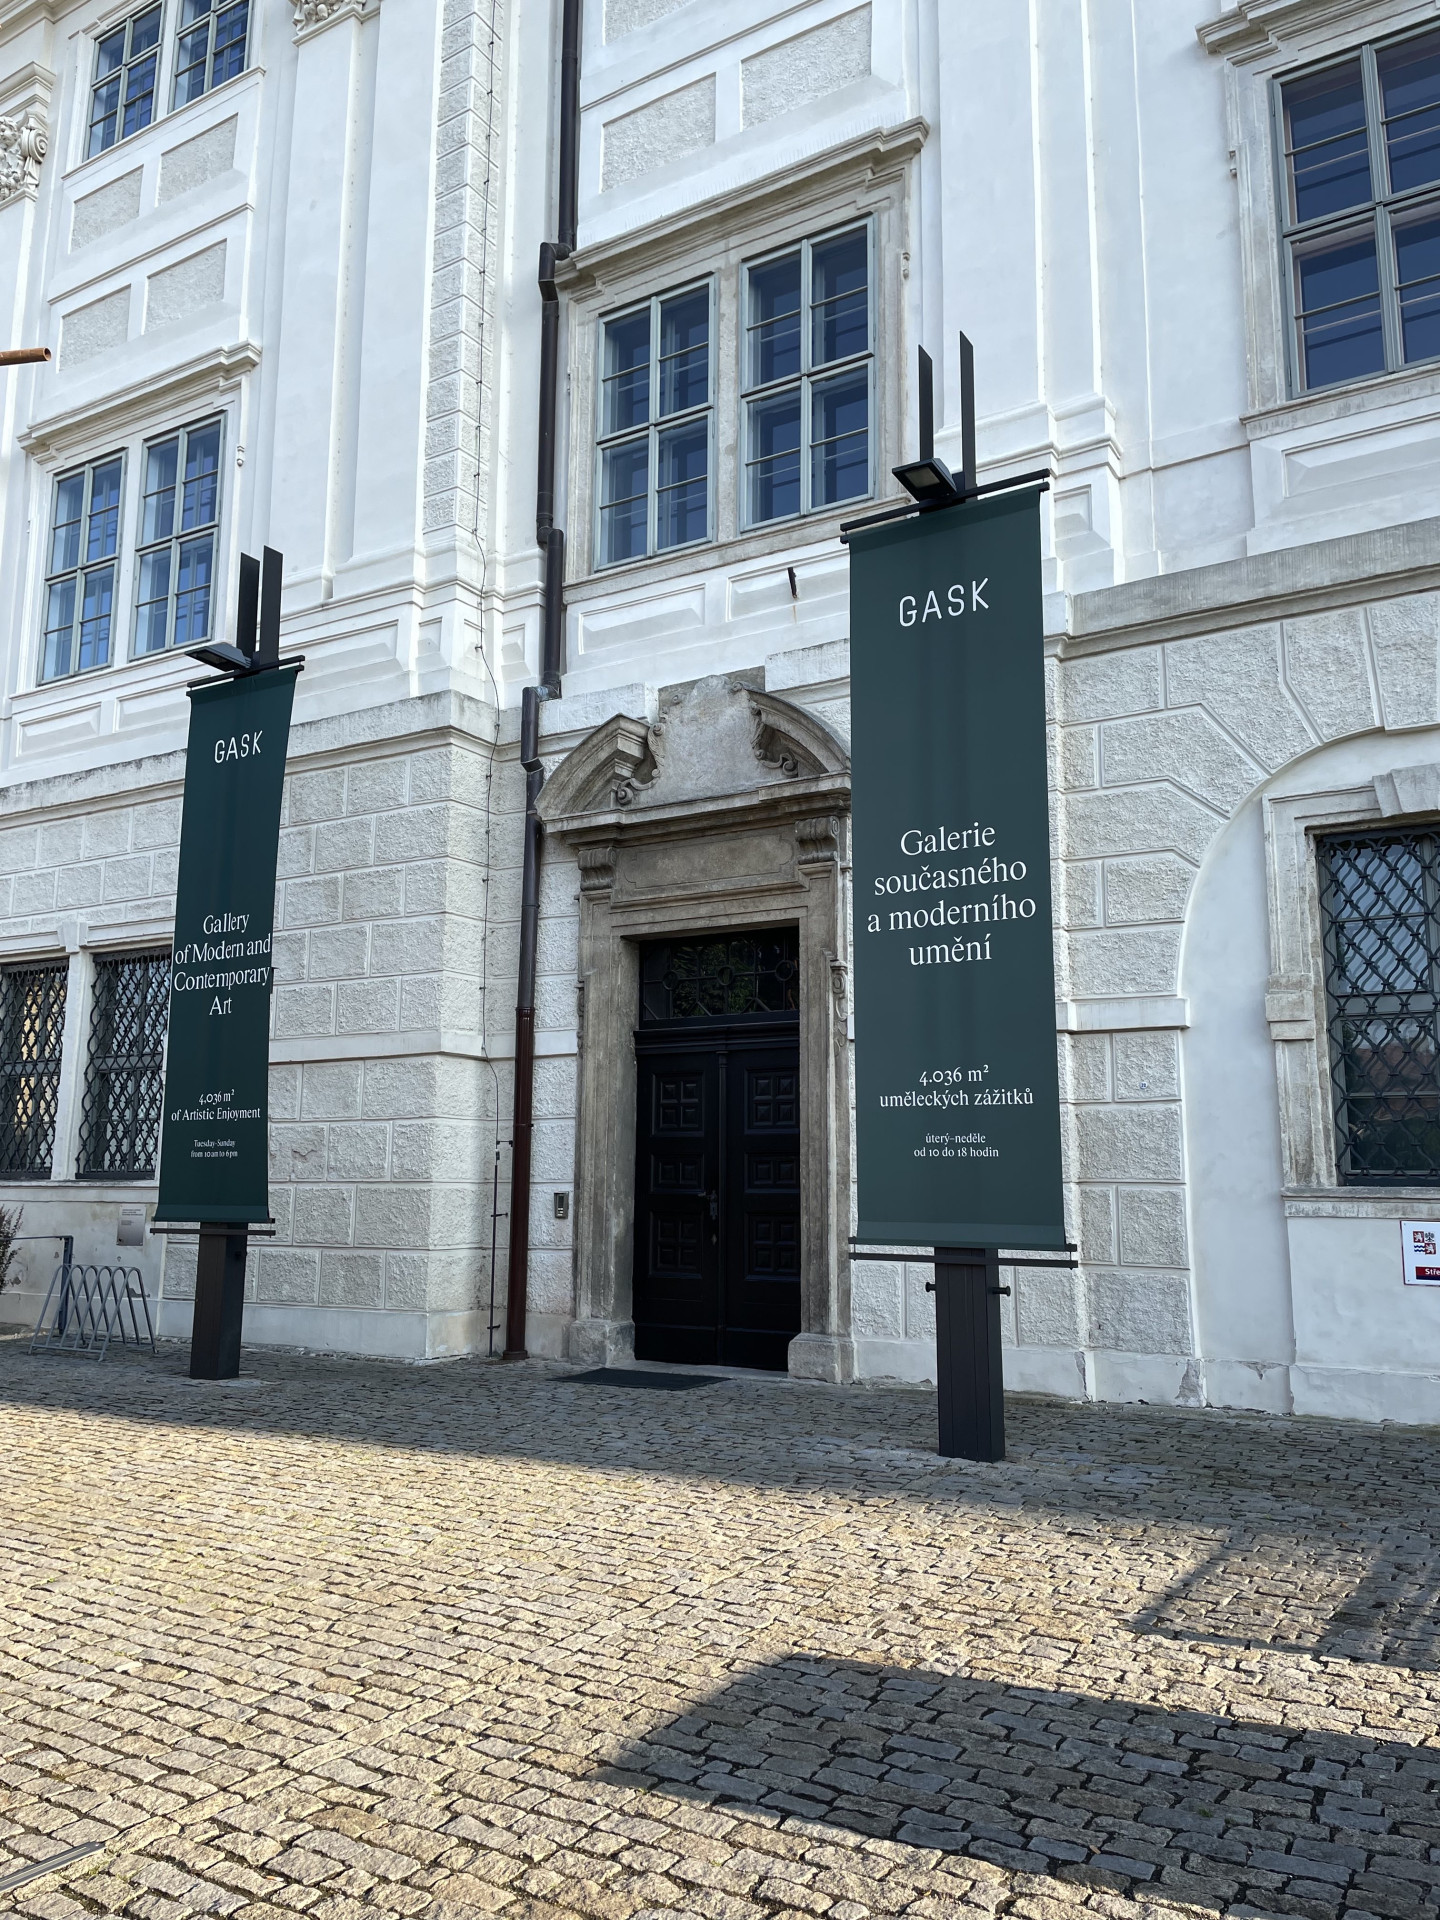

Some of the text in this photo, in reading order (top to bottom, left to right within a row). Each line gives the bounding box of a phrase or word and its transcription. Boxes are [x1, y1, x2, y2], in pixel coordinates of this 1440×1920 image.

[900, 578, 989, 626] GASK
[215, 730, 262, 763] GASK
[901, 822, 995, 855] Galerie
[874, 857, 1027, 896] současného
[203, 913, 249, 934] Gallery
[868, 892, 1036, 932] a moderního
[174, 933, 270, 964] of Modern and
[909, 933, 992, 965] umění
[174, 967, 270, 991] Contemporary
[209, 996, 232, 1015] Art
[919, 1067, 962, 1086] 4.036
[880, 1088, 1033, 1109] uměleckých zážitků
[171, 1107, 260, 1121] of Artistic Enjoyment
[191, 1150, 204, 1158] from
[914, 1147, 926, 1156] od
[942, 1147, 954, 1156] do
[958, 1147, 967, 1157] 18
[970, 1147, 998, 1157] hodin
